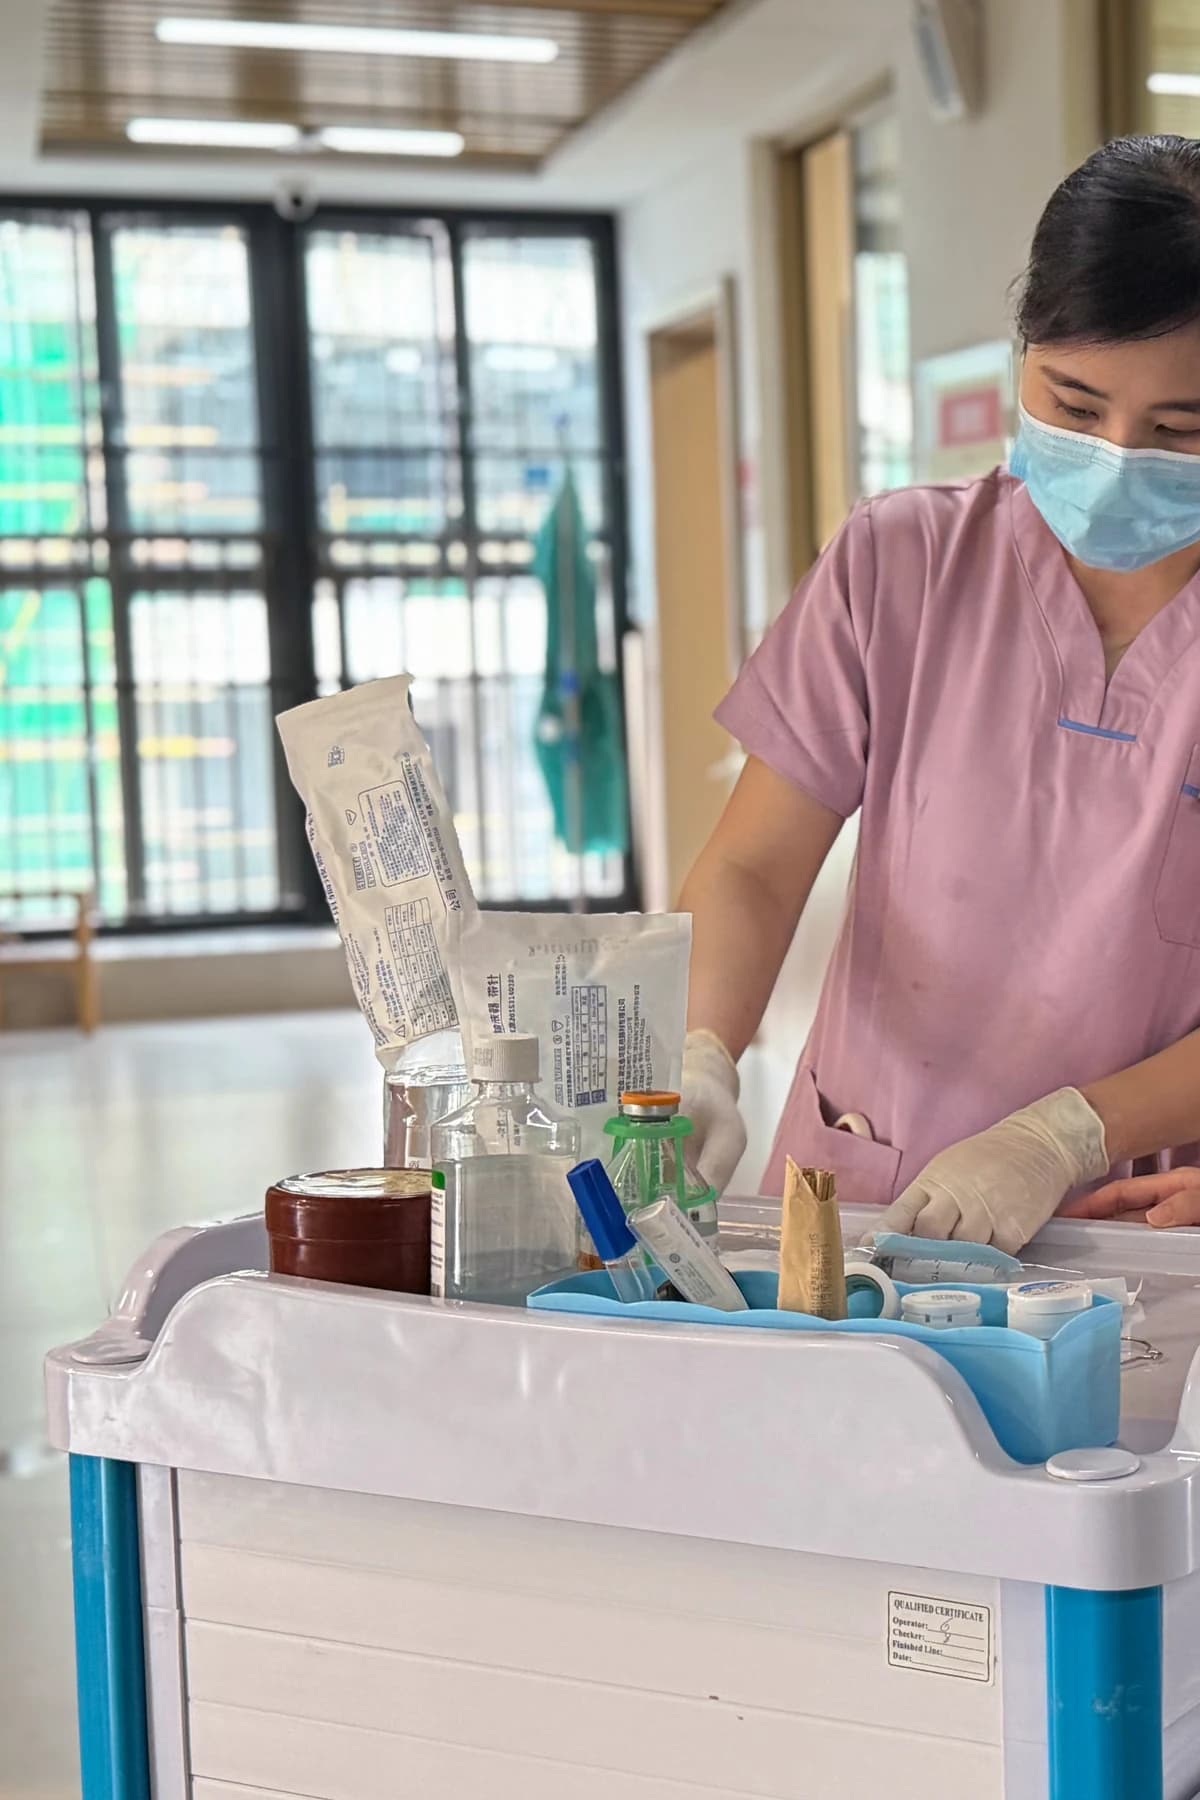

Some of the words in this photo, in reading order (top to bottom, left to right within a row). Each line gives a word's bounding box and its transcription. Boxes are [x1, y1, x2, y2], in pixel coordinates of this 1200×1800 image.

[894, 1599, 934, 1614] QUALIFIED
[935, 1606, 984, 1622] CERTIFICATE
[892, 1617, 928, 1630] Operator:
[892, 1629, 925, 1641] Checker:
[892, 1640, 923, 1652] Finished
[924, 1645, 943, 1656] Line:
[893, 1652, 912, 1662] Date:
